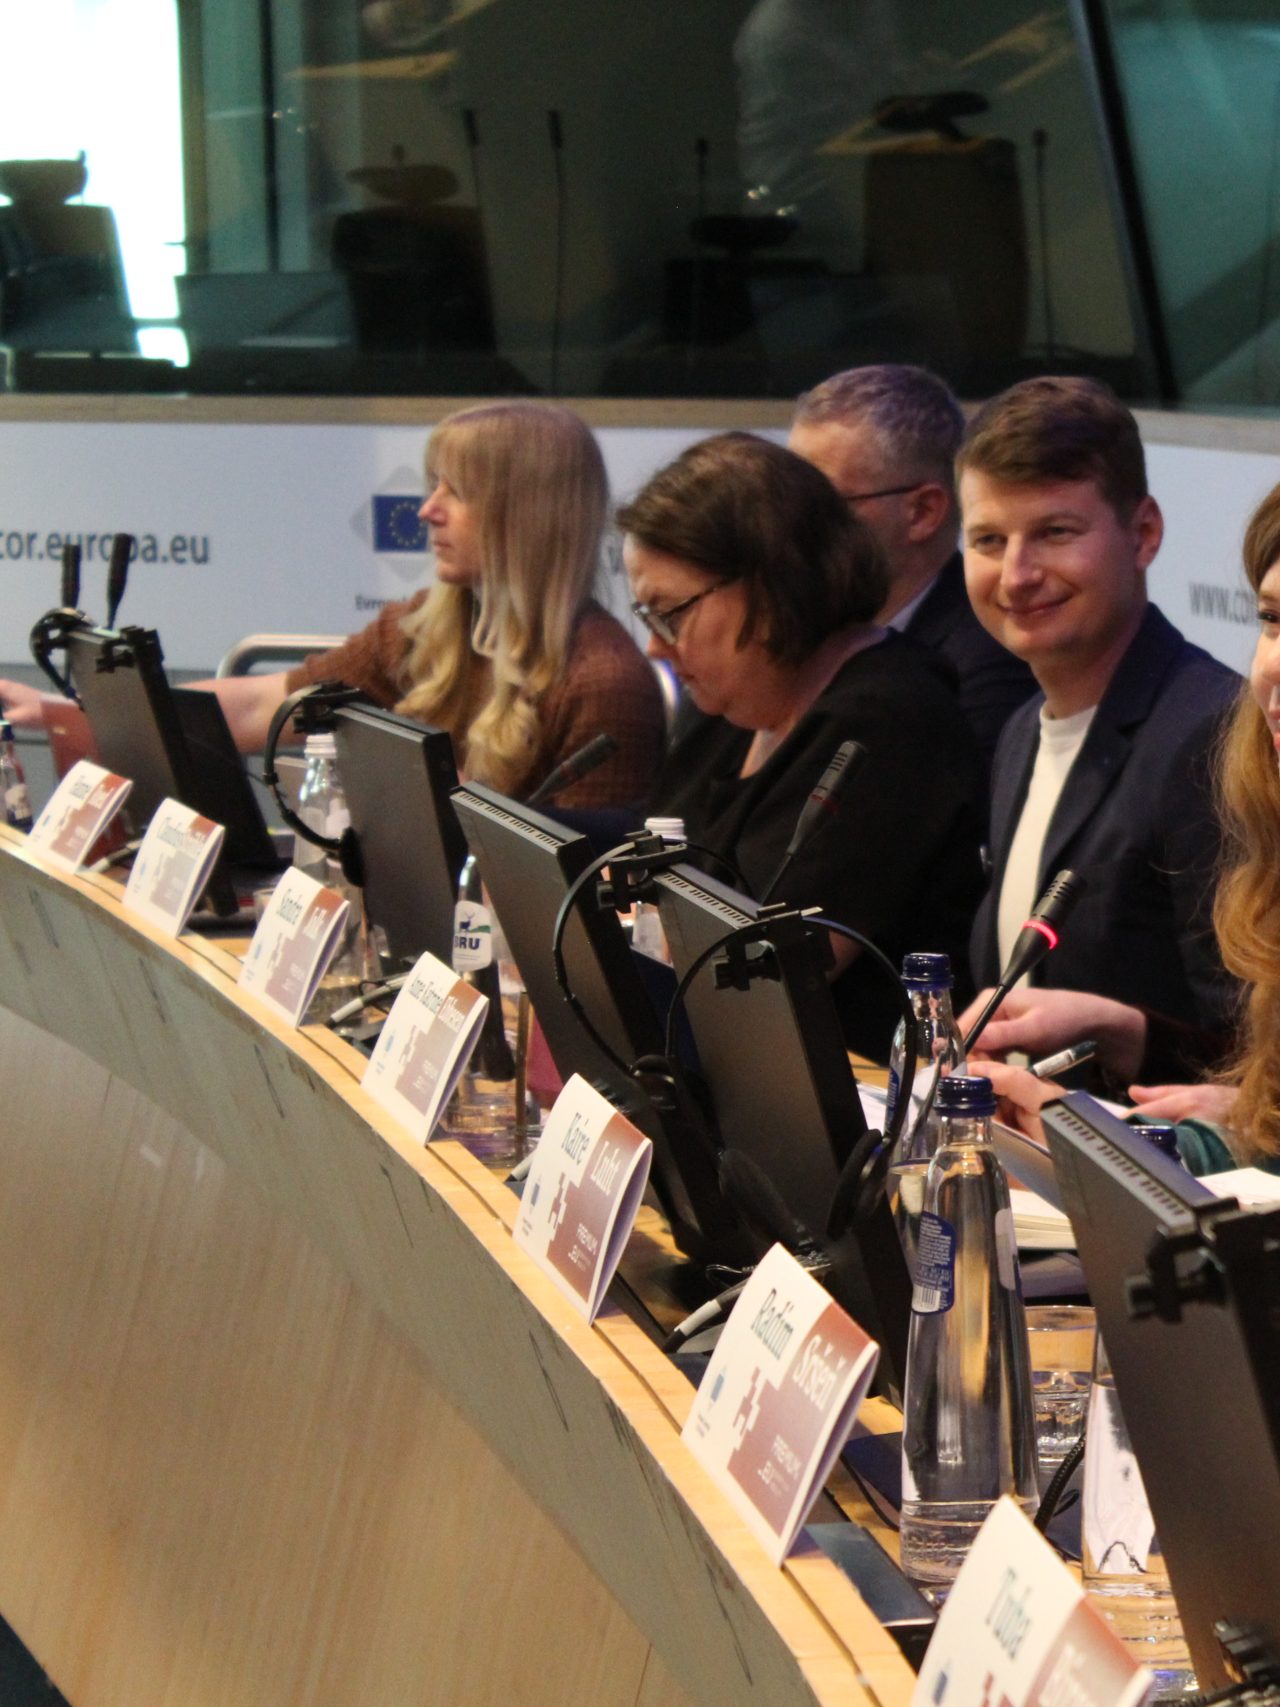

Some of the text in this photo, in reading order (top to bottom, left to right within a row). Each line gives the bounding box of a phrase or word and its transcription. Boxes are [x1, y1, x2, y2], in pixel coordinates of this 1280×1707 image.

[561, 1111, 622, 1197] Kaire Luht
[750, 1287, 848, 1413] Radim Sršeň
